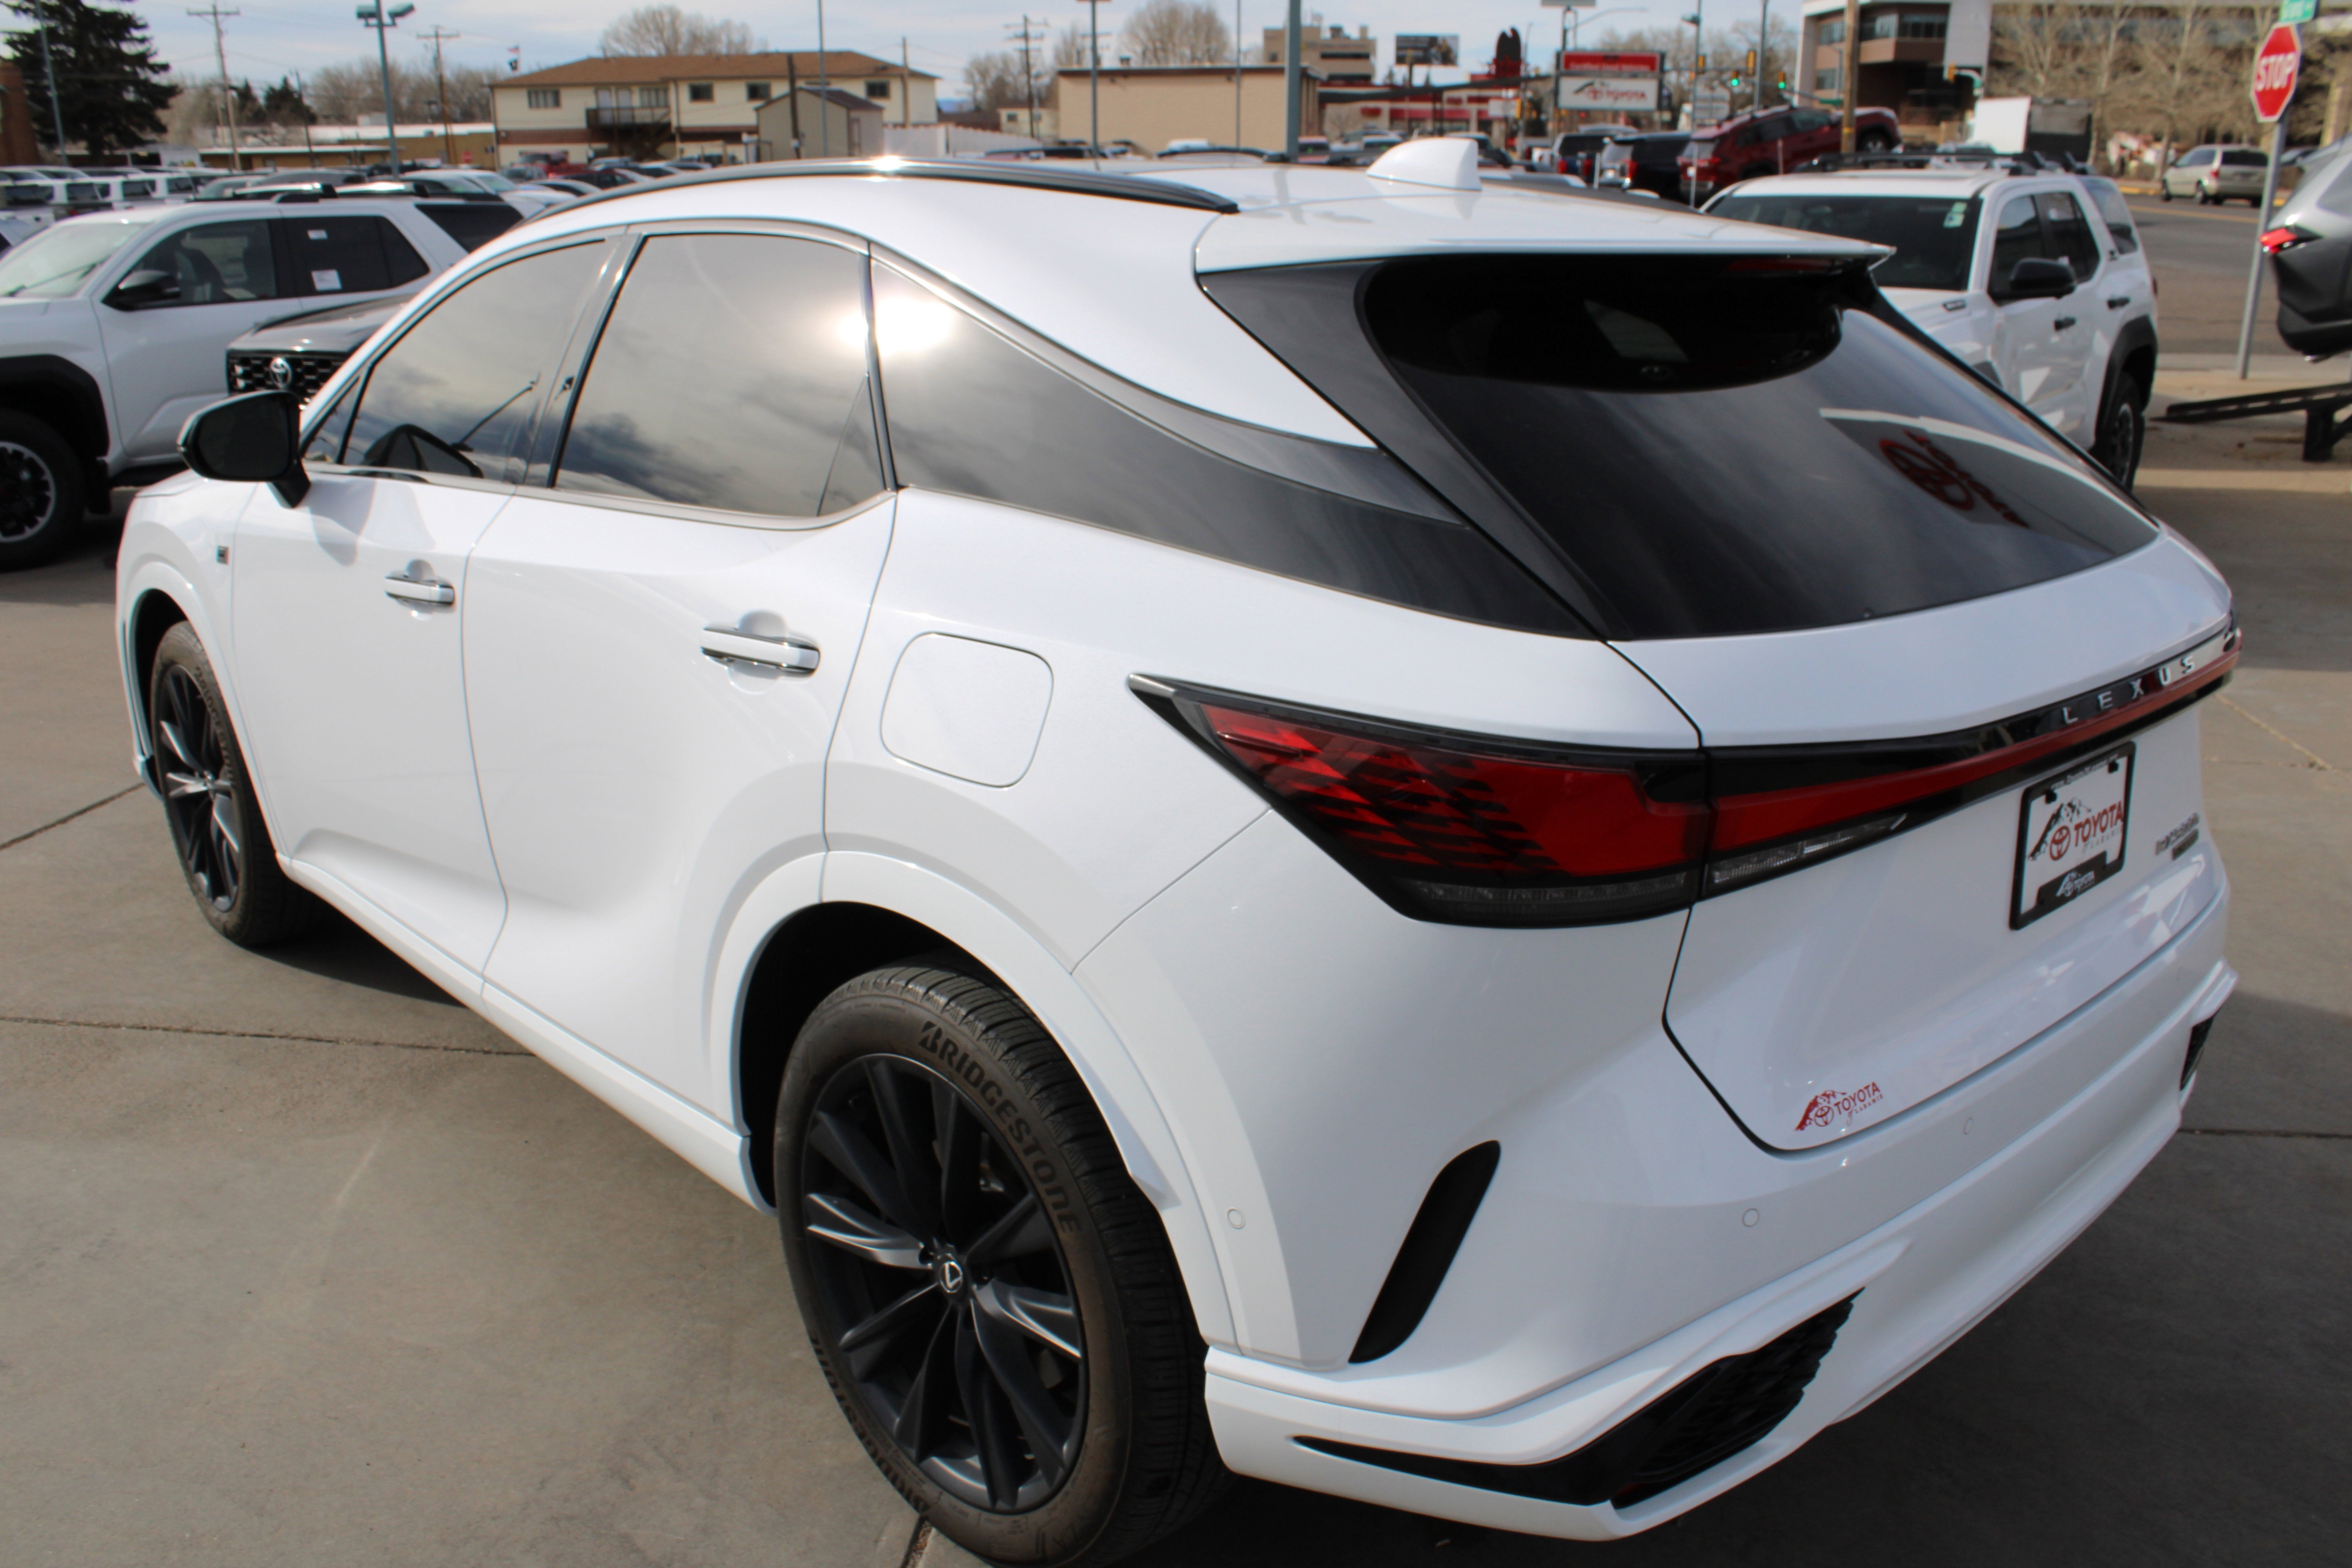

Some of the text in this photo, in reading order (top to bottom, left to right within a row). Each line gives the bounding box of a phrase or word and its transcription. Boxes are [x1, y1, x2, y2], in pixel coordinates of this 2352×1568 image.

[2256, 52, 2297, 91] STOP
[1606, 89, 1646, 100] TOYOTA
[2063, 655, 2195, 724] LEXUS
[2074, 801, 2123, 847] TOYOTA
[1834, 1082, 1880, 1115] TOYOTA
[918, 1021, 1083, 1234] BRIDGESTONE
